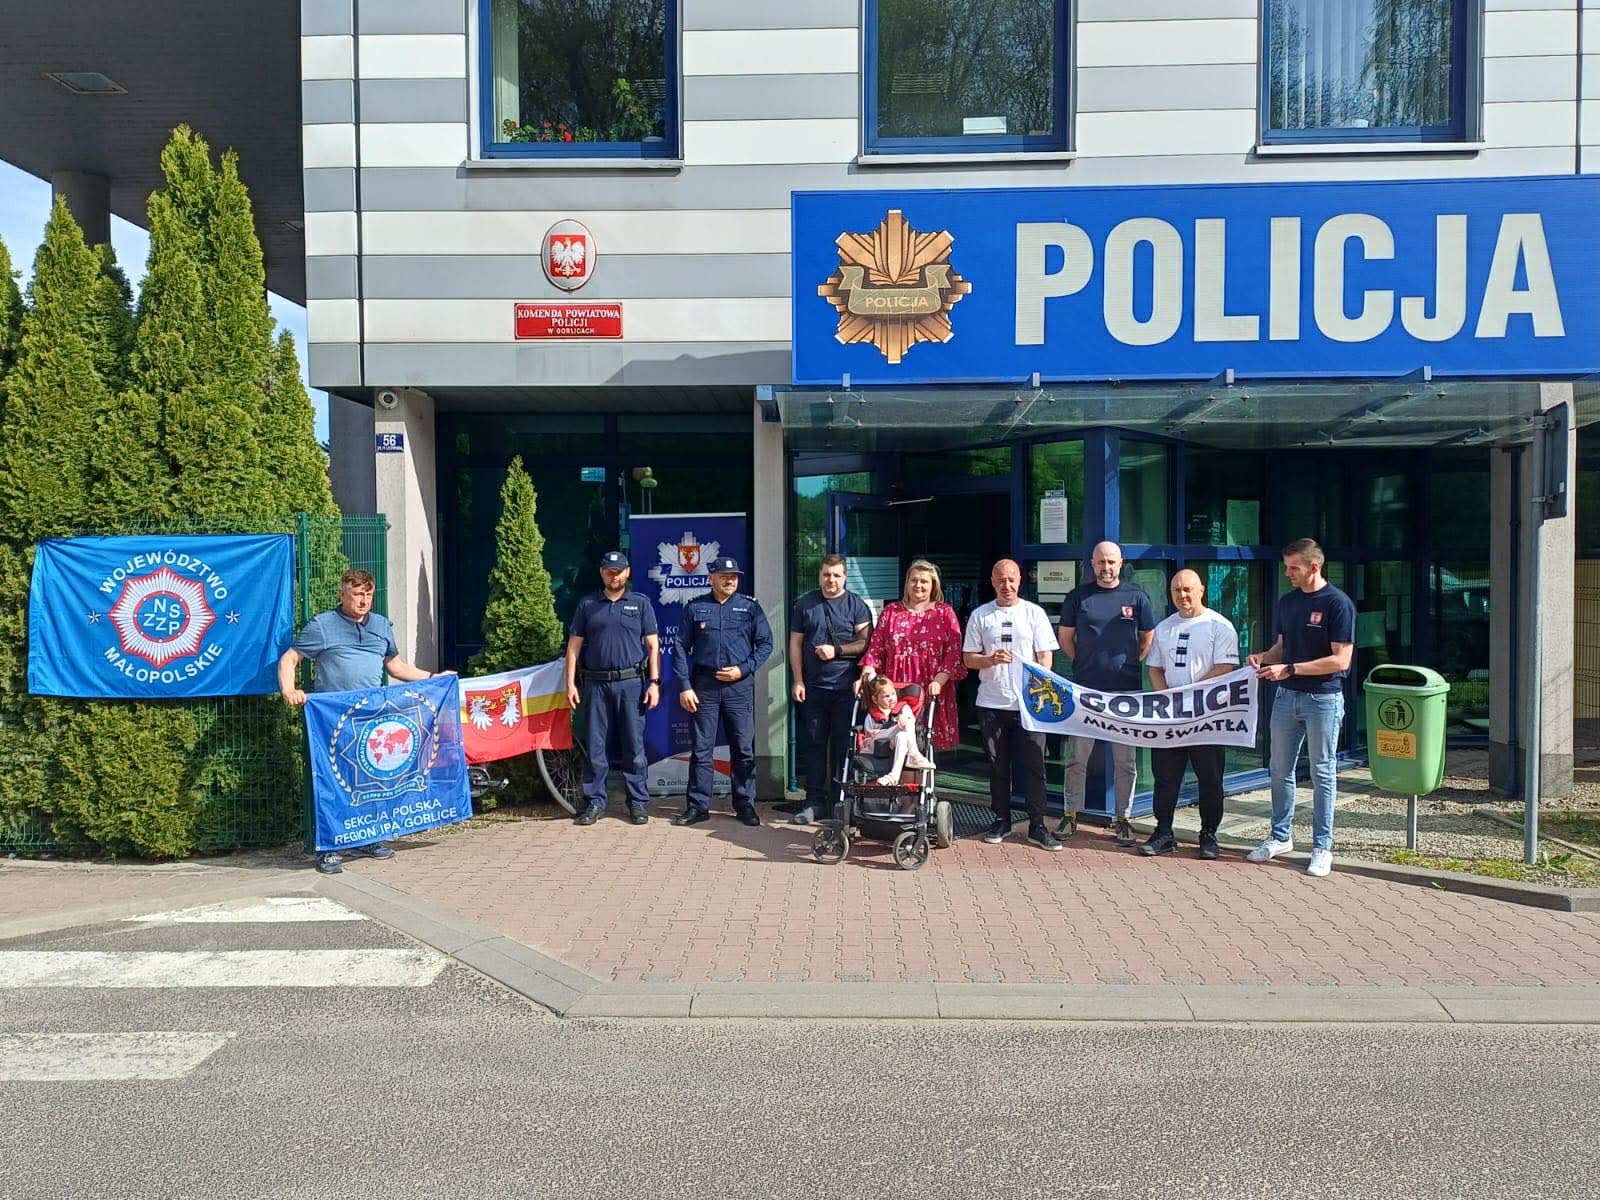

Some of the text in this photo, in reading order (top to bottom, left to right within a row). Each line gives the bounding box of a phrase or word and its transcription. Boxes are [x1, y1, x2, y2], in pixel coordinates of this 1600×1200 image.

[1015, 213, 1566, 346] POLICJA
[518, 309, 620, 318] KOMENDA POWIATOWA
[865, 297, 929, 308] POLICJA
[551, 318, 588, 327] POLICJI
[383, 434, 397, 446] 56
[99, 549, 228, 600] WOJEWÓDZTWO
[104, 642, 223, 684] MAŁOPOLSKIE
[1079, 678, 1250, 720] GORLICE
[1083, 715, 1249, 740] MIASTO ŚWIATŁA
[334, 806, 458, 846] REGION IPA GORLICE
[343, 798, 442, 830] SEKCJA POLSKA
